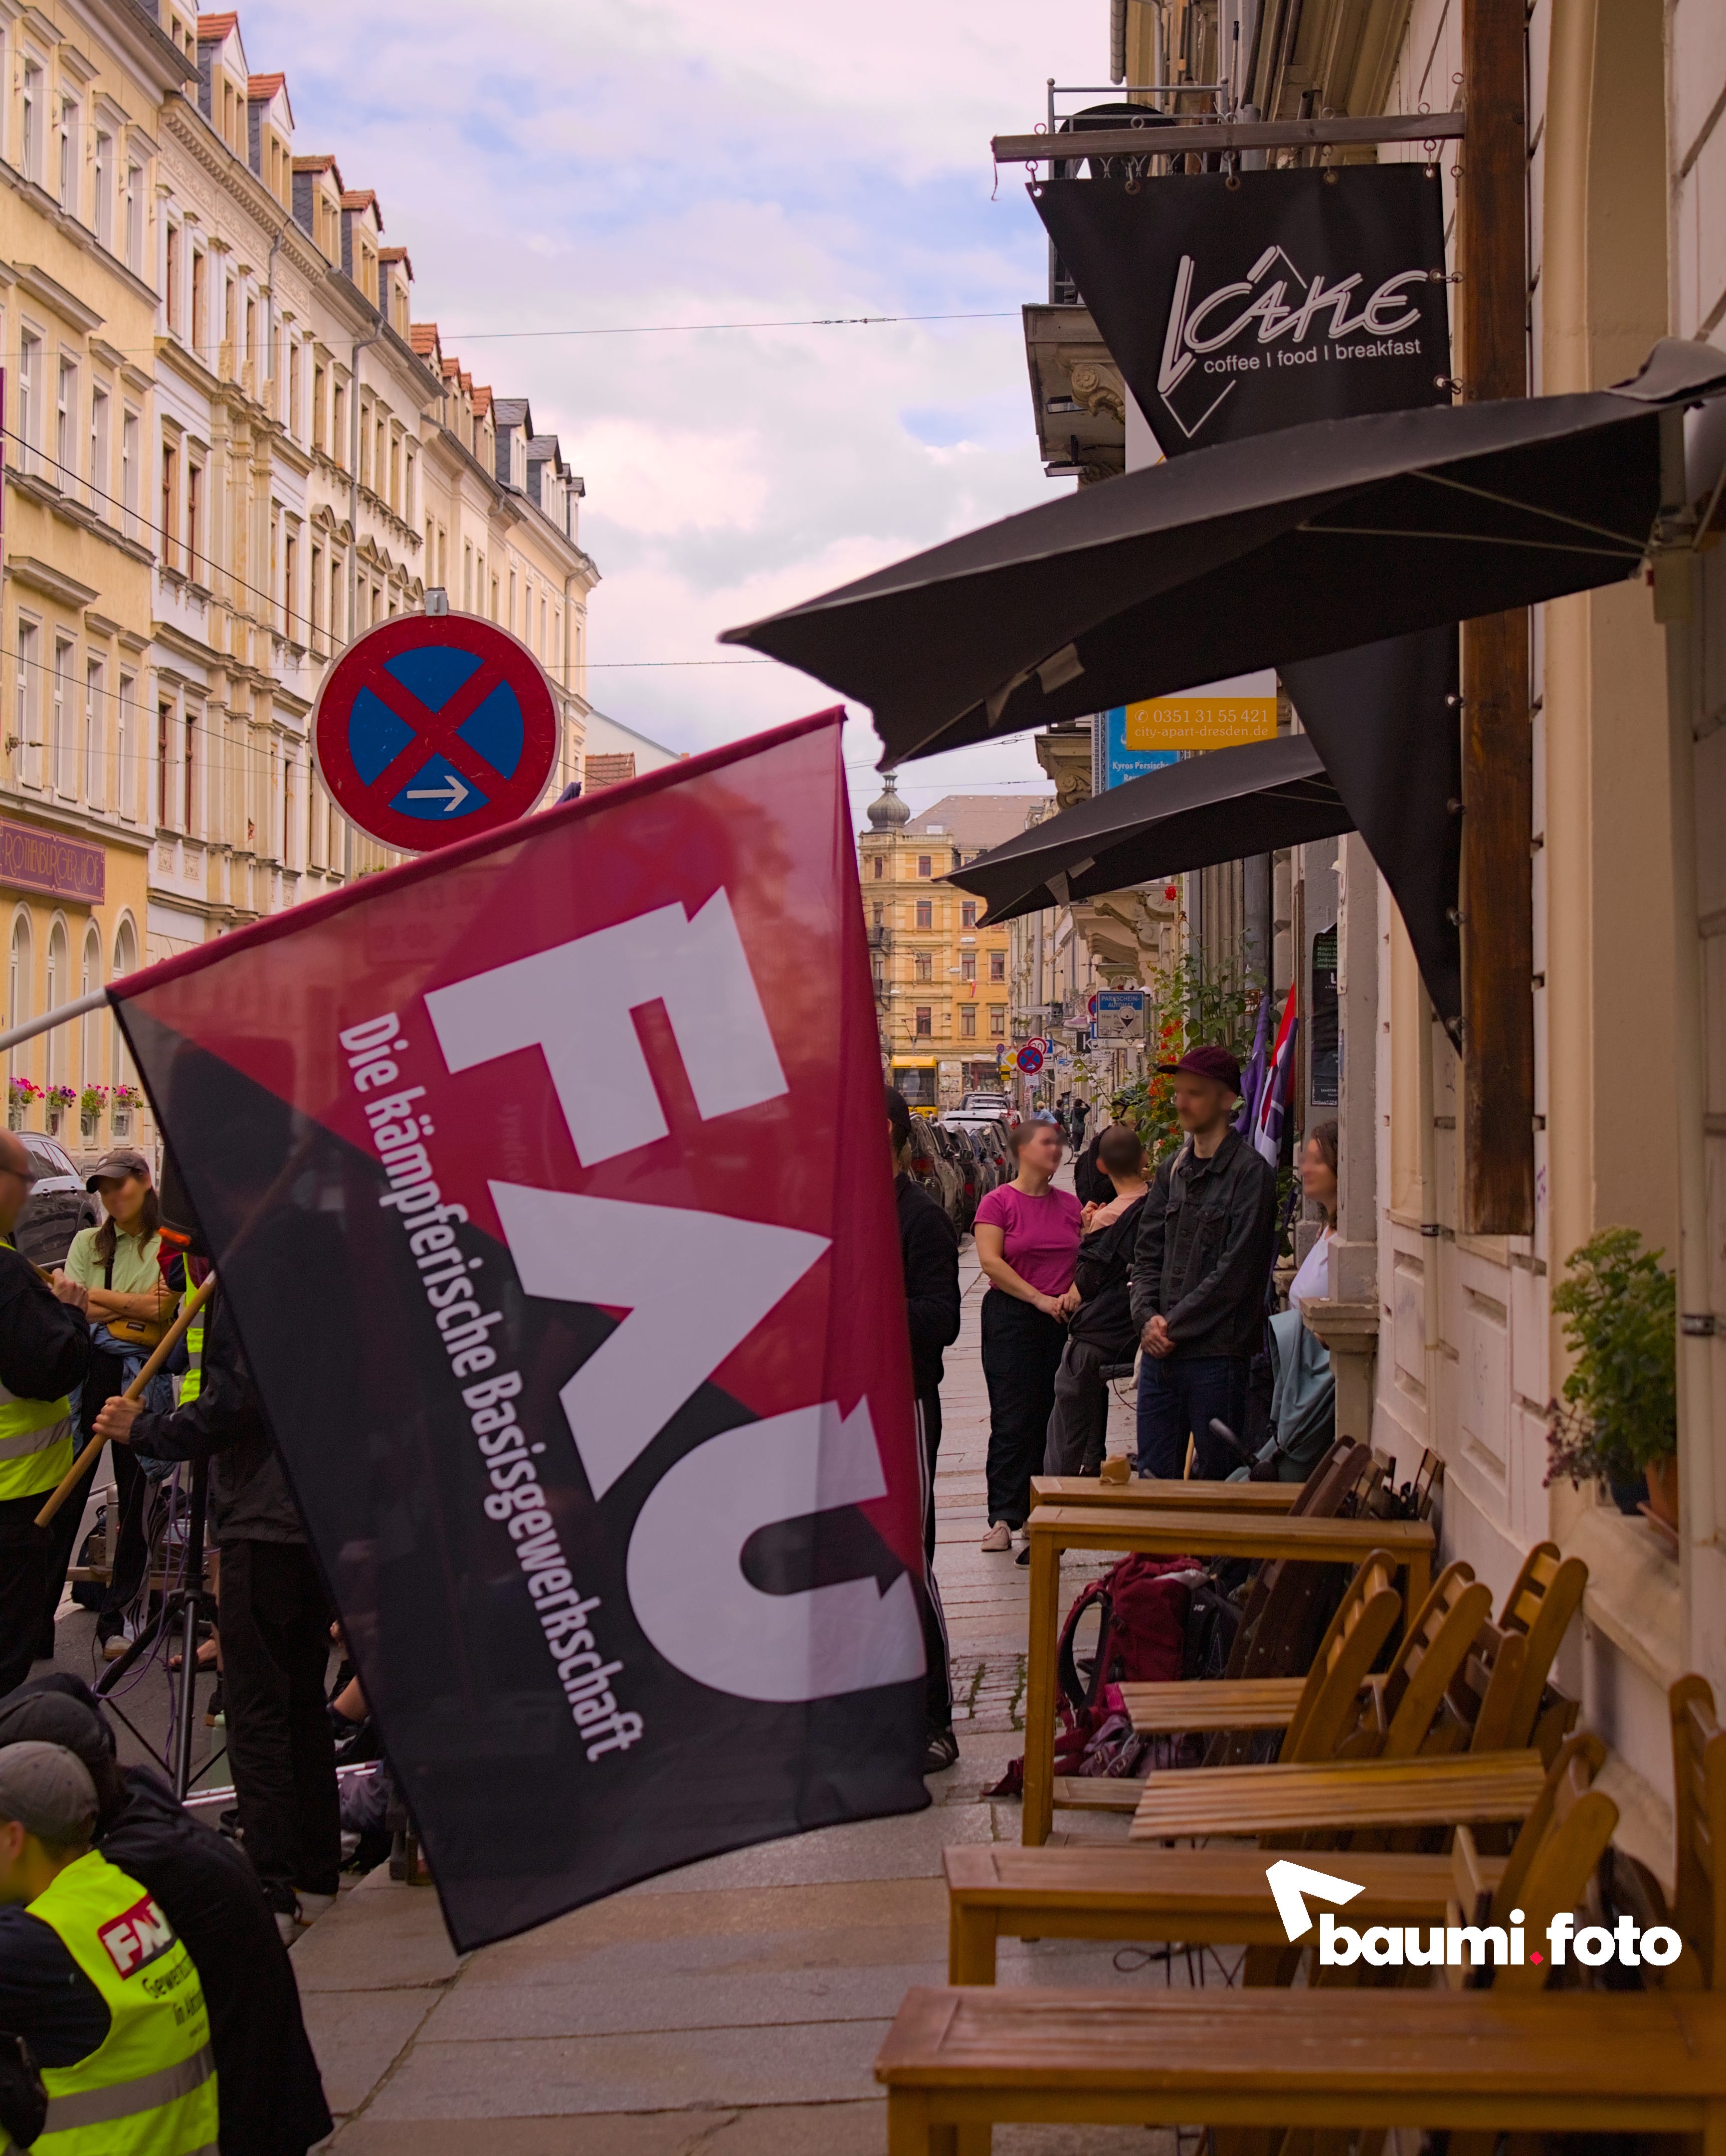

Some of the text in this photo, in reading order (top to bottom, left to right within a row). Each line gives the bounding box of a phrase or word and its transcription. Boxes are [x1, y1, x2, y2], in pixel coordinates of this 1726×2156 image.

[1204, 353, 1260, 372] coffee
[1278, 346, 1317, 366] food
[1336, 339, 1421, 360] breakfast
[1135, 725, 1268, 739] city-apart-dresden.de
[1153, 709, 1268, 723] 0351 31 55 421
[1113, 762, 1134, 772] Kyros
[5, 832, 99, 891] ROTHENBURGER HOF
[340, 1012, 408, 1092] Die
[366, 1086, 502, 1377] kämpferische
[424, 886, 926, 1702] FAU
[462, 1371, 642, 1761] Basisgewerkschaft
